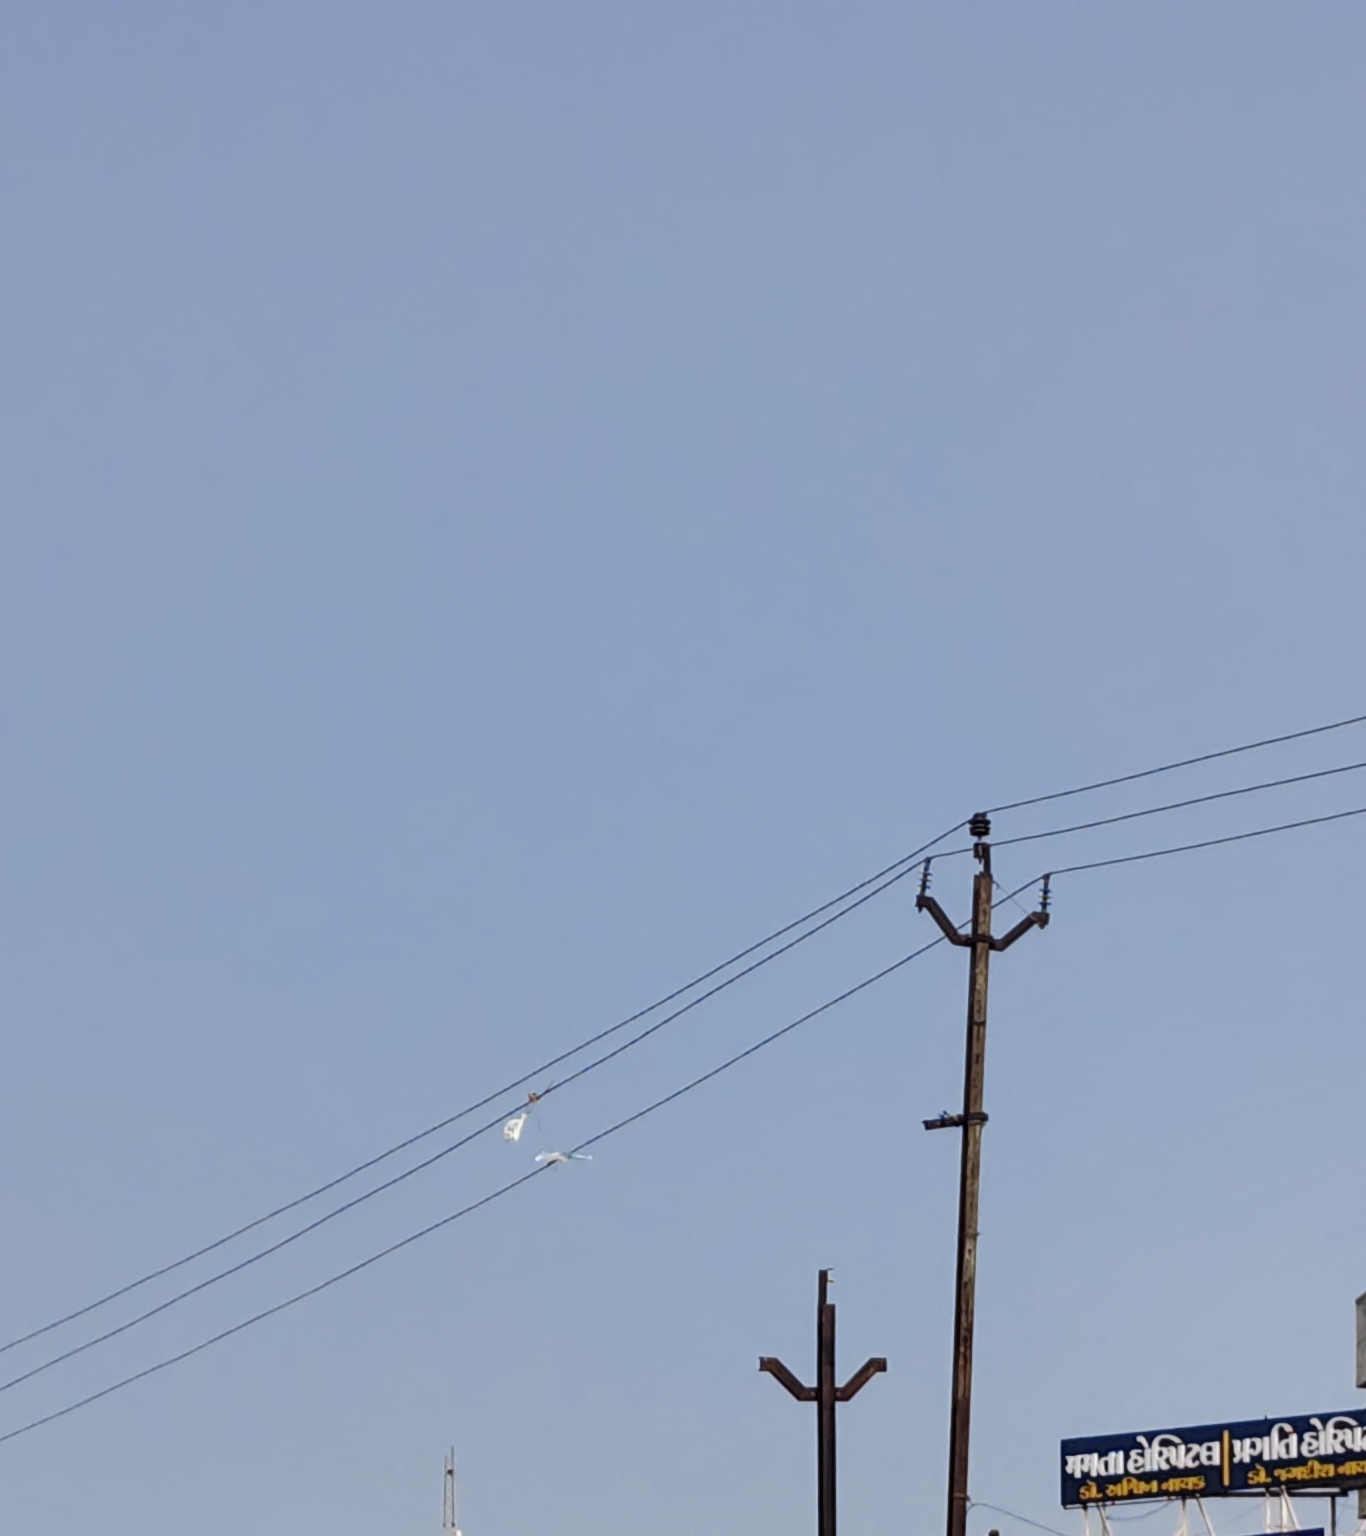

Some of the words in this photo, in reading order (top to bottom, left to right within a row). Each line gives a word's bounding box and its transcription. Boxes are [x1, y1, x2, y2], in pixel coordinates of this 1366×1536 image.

[1065, 1449, 1125, 1478] મમતા
[1127, 1433, 1221, 1475] હોસ્પિટલ
[1231, 1422, 1298, 1464] પ્રગતિ
